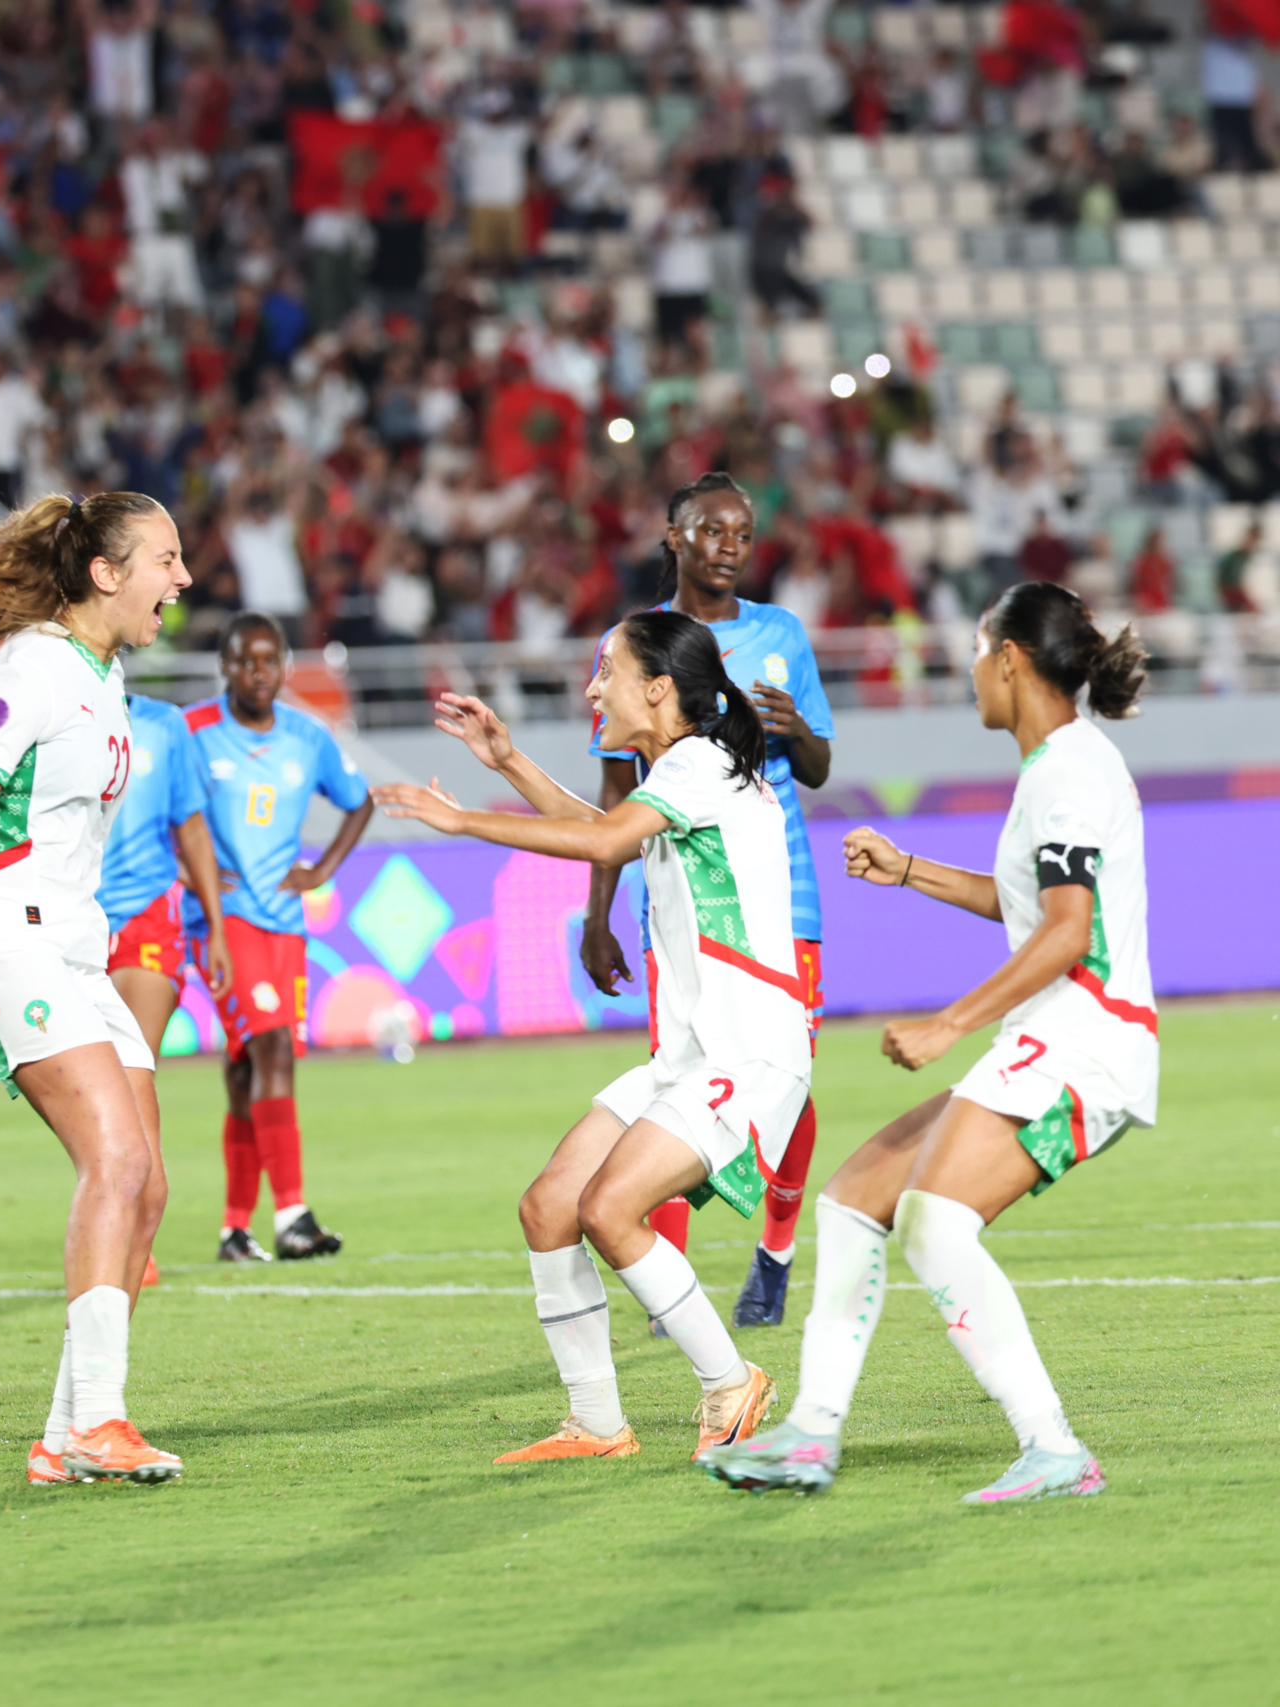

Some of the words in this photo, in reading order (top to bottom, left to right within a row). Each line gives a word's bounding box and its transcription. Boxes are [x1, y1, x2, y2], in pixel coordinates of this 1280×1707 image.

[101, 735, 130, 802] 21
[246, 784, 275, 826] 13
[140, 943, 162, 973] 5
[1008, 1034, 1047, 1072] 7
